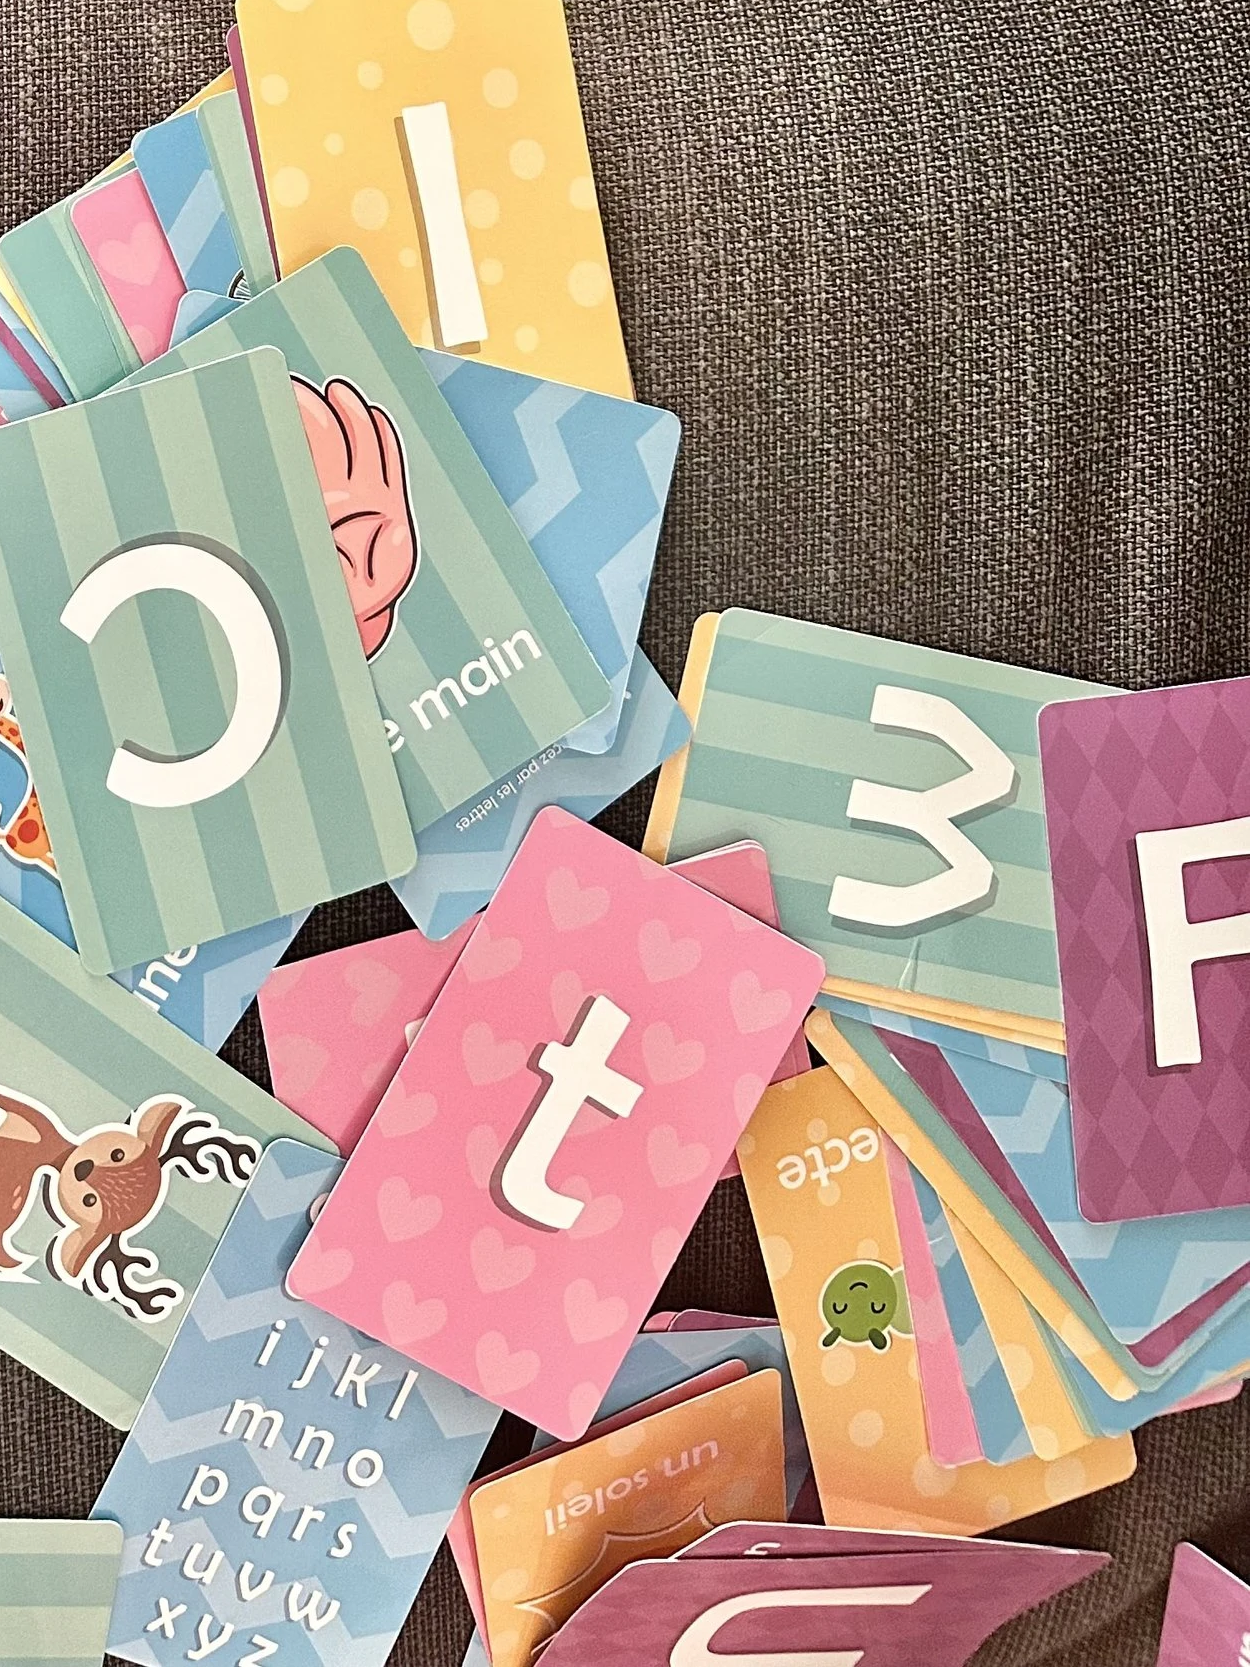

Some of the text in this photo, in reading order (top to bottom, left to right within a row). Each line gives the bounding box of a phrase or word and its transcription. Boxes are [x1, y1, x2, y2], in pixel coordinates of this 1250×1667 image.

[408, 628, 543, 732] main
[496, 780, 517, 799] les
[516, 758, 550, 785] par
[455, 795, 499, 832] lettres
[500, 994, 645, 1231] t
[776, 1126, 879, 1190] ecte
[544, 1439, 719, 1536] un soleil
